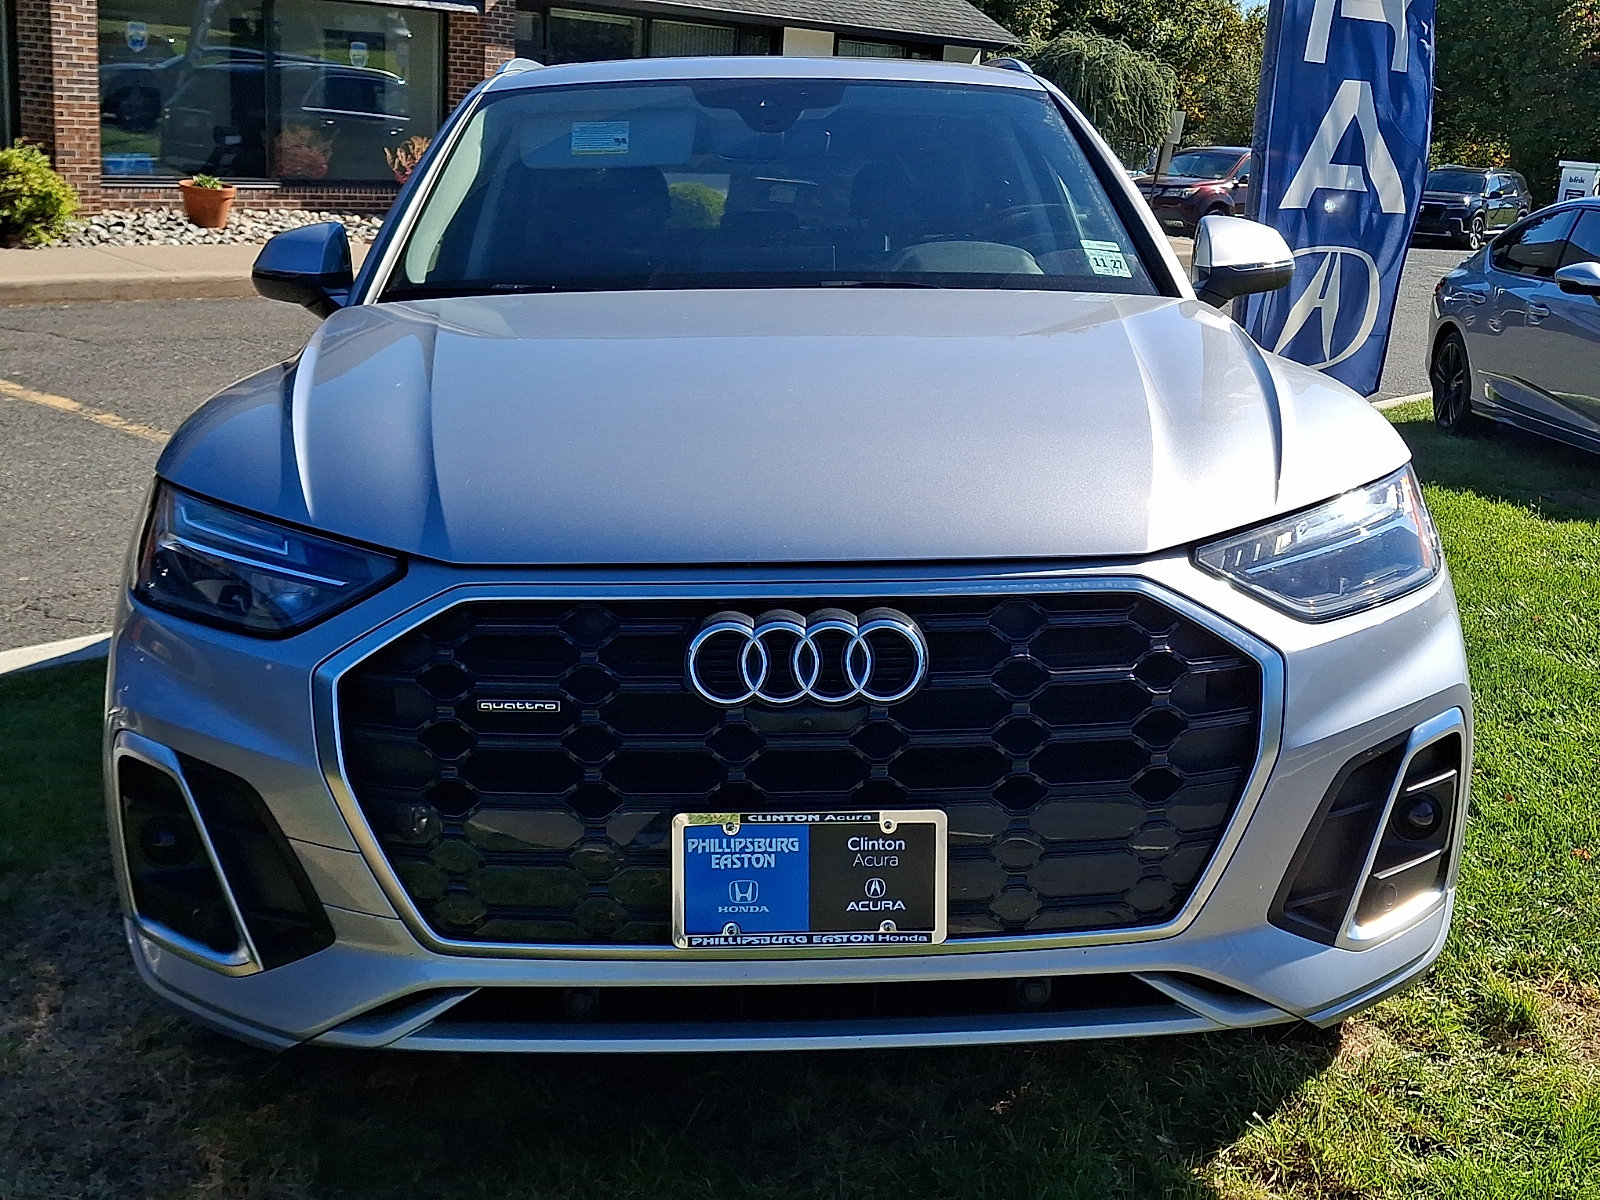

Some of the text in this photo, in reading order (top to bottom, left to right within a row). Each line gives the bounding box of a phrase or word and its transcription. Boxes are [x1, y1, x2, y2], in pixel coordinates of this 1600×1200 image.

[1569, 176, 1585, 184] blink
[1092, 257, 1123, 270] 11 27
[480, 702, 556, 711] quattro
[747, 813, 872, 823] CLINTON Acura
[687, 837, 800, 854] PHILLIPSBURG
[847, 837, 906, 852] Clinton
[711, 853, 776, 870] EASTON
[852, 852, 899, 868] Acura
[717, 905, 770, 914] HONDA
[845, 900, 907, 912] ACURA
[691, 933, 929, 947] PHILLIPSBURG EASTON Honda
